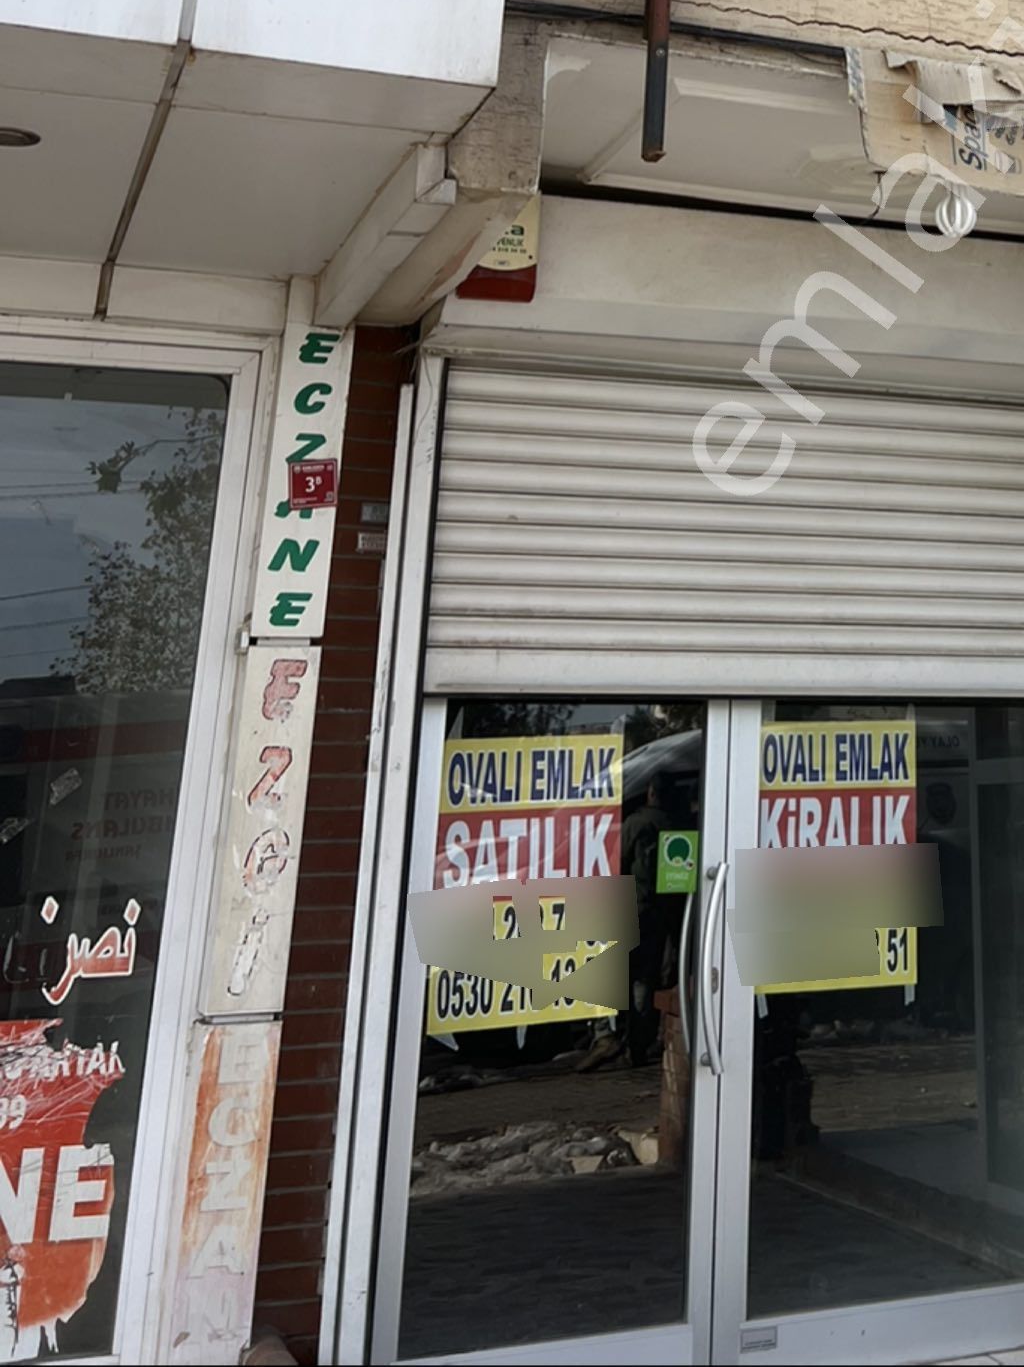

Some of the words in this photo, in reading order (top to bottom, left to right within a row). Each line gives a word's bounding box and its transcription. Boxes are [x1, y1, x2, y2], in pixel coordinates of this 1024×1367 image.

[267, 331, 341, 628] ECZNE
[447, 750, 521, 807] OVALI
[529, 745, 616, 804] EMLAK
[763, 732, 826, 785] OVALI
[834, 730, 910, 783] EMLAK
[442, 812, 613, 889] SATILIK
